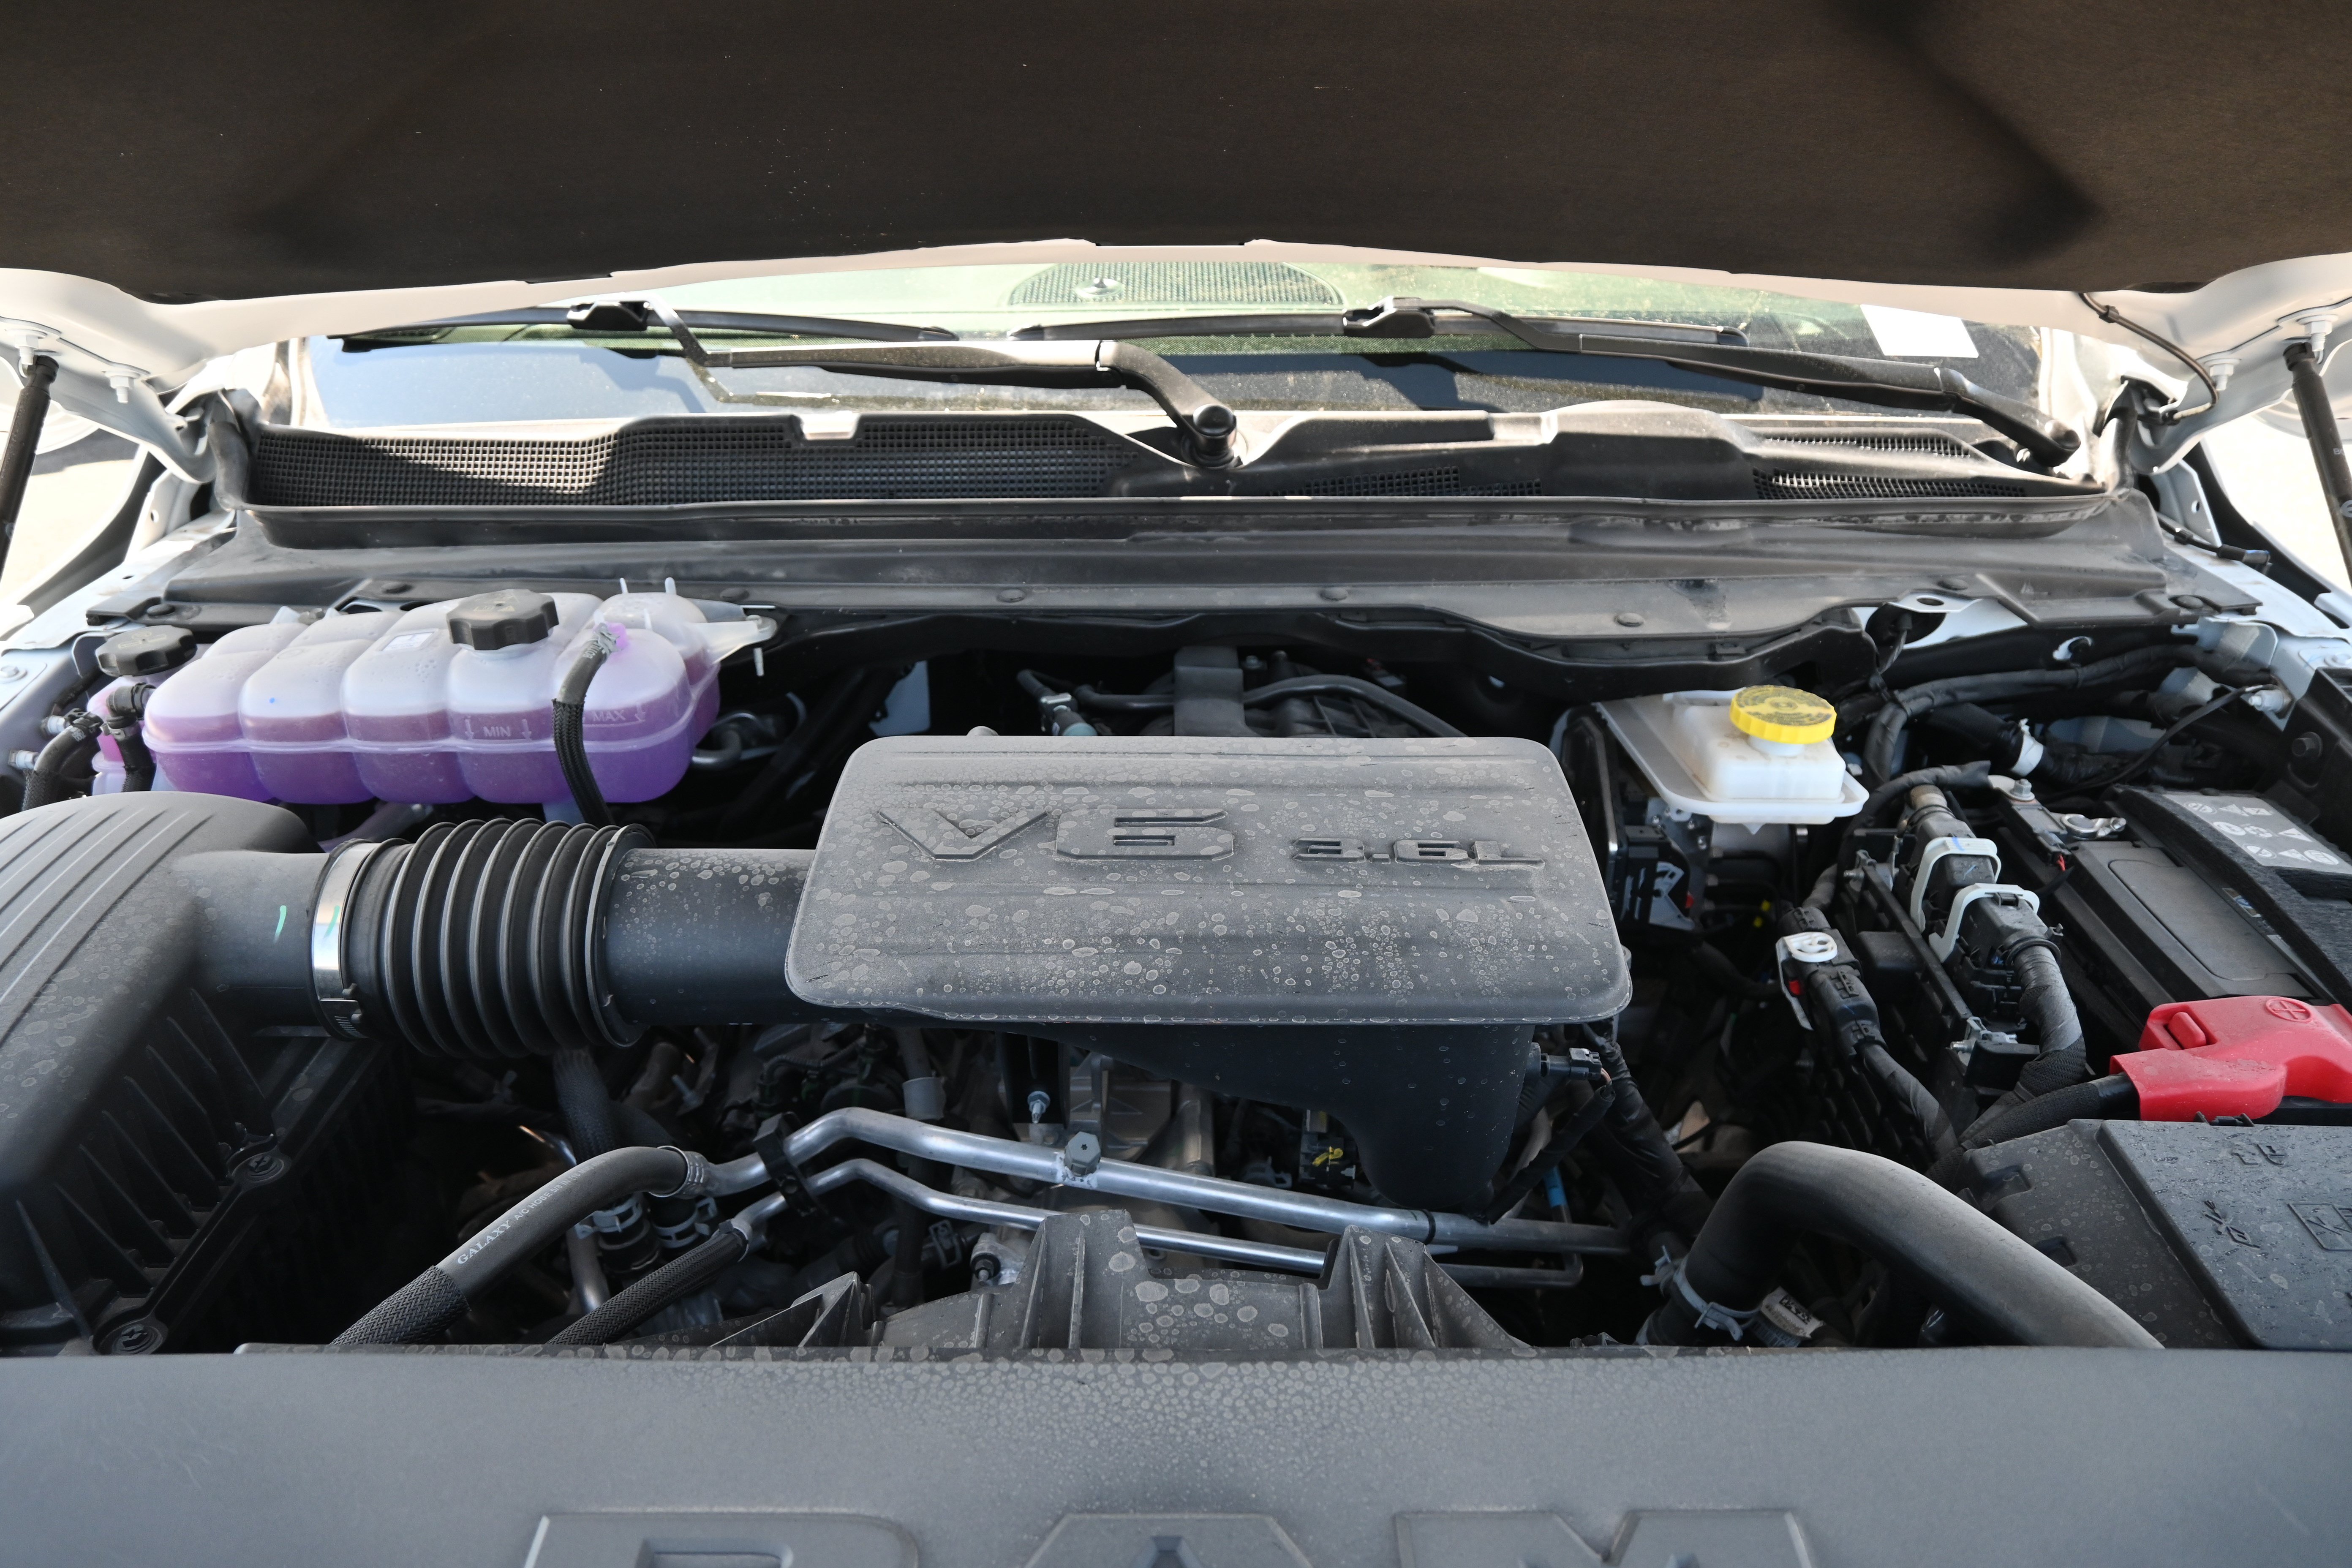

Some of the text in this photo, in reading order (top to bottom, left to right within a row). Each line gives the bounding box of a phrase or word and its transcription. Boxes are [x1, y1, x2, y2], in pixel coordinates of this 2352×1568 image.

[483, 726, 511, 737] MIN
[593, 710, 626, 721] MAX
[877, 807, 1545, 868] V6 3.6L
[457, 1220, 511, 1264] GALAXY
[514, 1208, 529, 1220] A/C
[528, 1192, 553, 1209] HOSE
